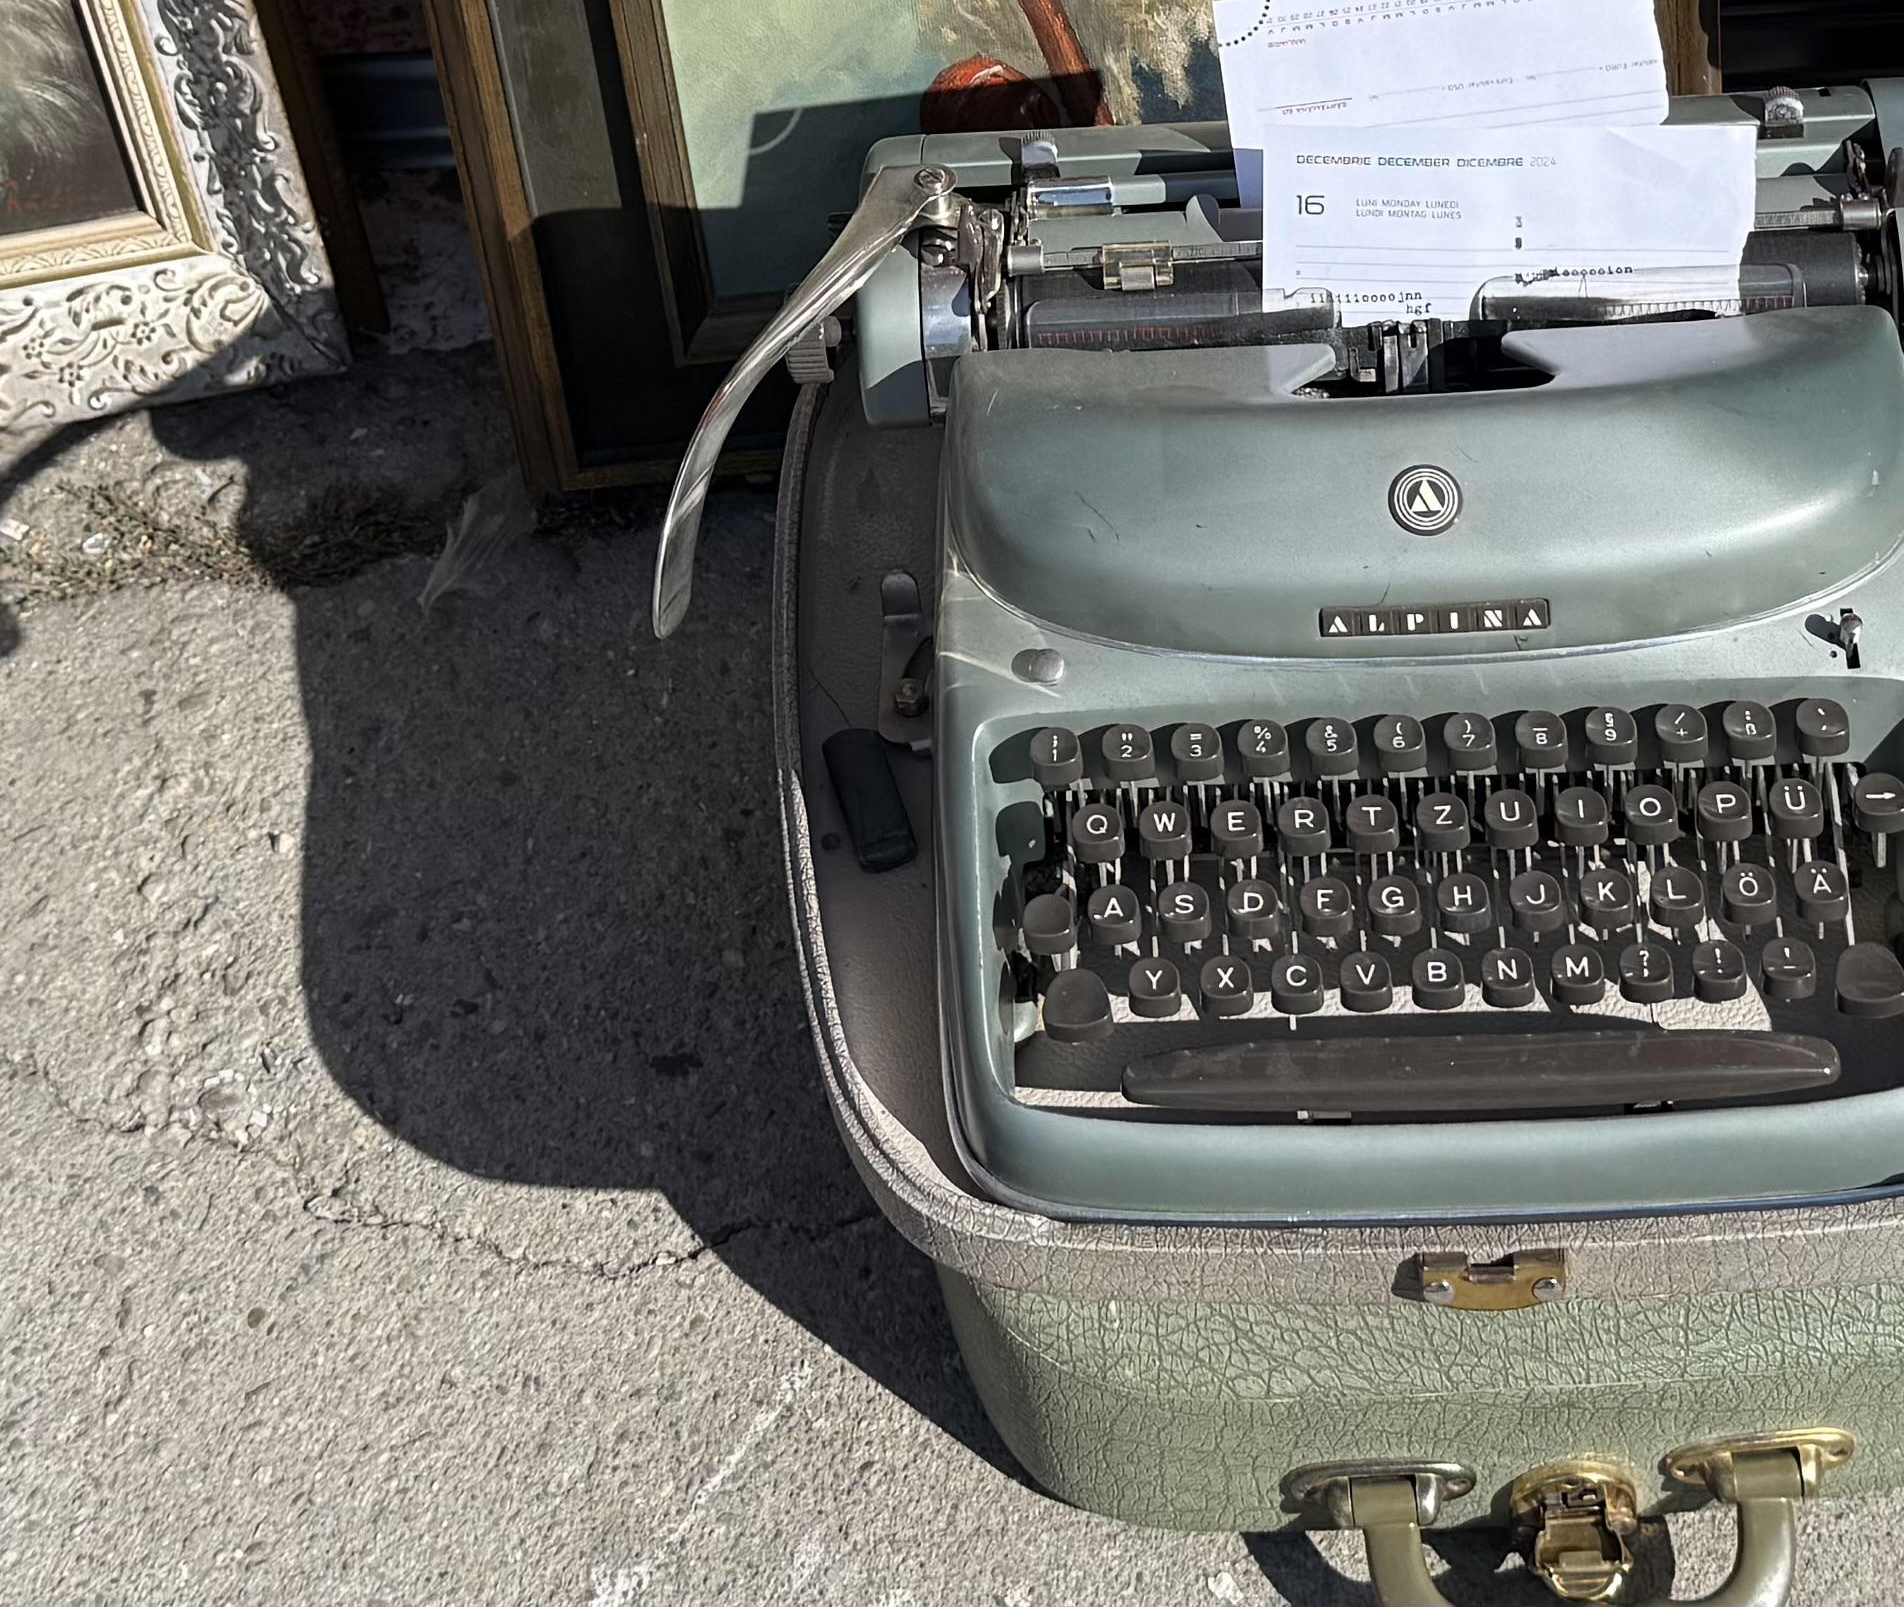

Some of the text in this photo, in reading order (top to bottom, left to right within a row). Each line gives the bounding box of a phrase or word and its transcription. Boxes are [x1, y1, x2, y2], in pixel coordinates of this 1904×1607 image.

[1296, 155, 1556, 168] DECEMBRIE DECEMBER DICEMBRE 2024
[1296, 195, 1325, 215] 16
[1356, 198, 1459, 209] LUNI MONDAY LUNEDI
[1356, 209, 1462, 219] LUNDI MONTAG LUNES
[1328, 608, 1542, 633] ALPINA
[1121, 745, 1133, 758] 2
[1190, 744, 1202, 757] 3
[1326, 739, 1337, 752] 5
[1393, 735, 1405, 749] 6
[1463, 734, 1476, 747] 7
[1536, 732, 1547, 745] 8
[1604, 728, 1617, 741] 9
[1086, 814, 1108, 834] Q
[1153, 812, 1176, 832] W
[1228, 811, 1245, 831] E
[1295, 809, 1314, 828] R
[1361, 806, 1381, 826] T
[1433, 805, 1452, 825] Z
[1499, 801, 1520, 821] U
[1639, 797, 1662, 817] O
[1716, 794, 1736, 814] P
[1784, 785, 1806, 810] Ü
[1103, 867, 1832, 917] A S D F G H J K L Ö Ä
[1145, 970, 1163, 989] Y
[1217, 967, 1234, 988] X
[1286, 966, 1308, 987] C
[1355, 964, 1377, 985] V
[1427, 962, 1448, 983] B
[1497, 958, 1517, 980] N
[1565, 956, 1589, 978] M
